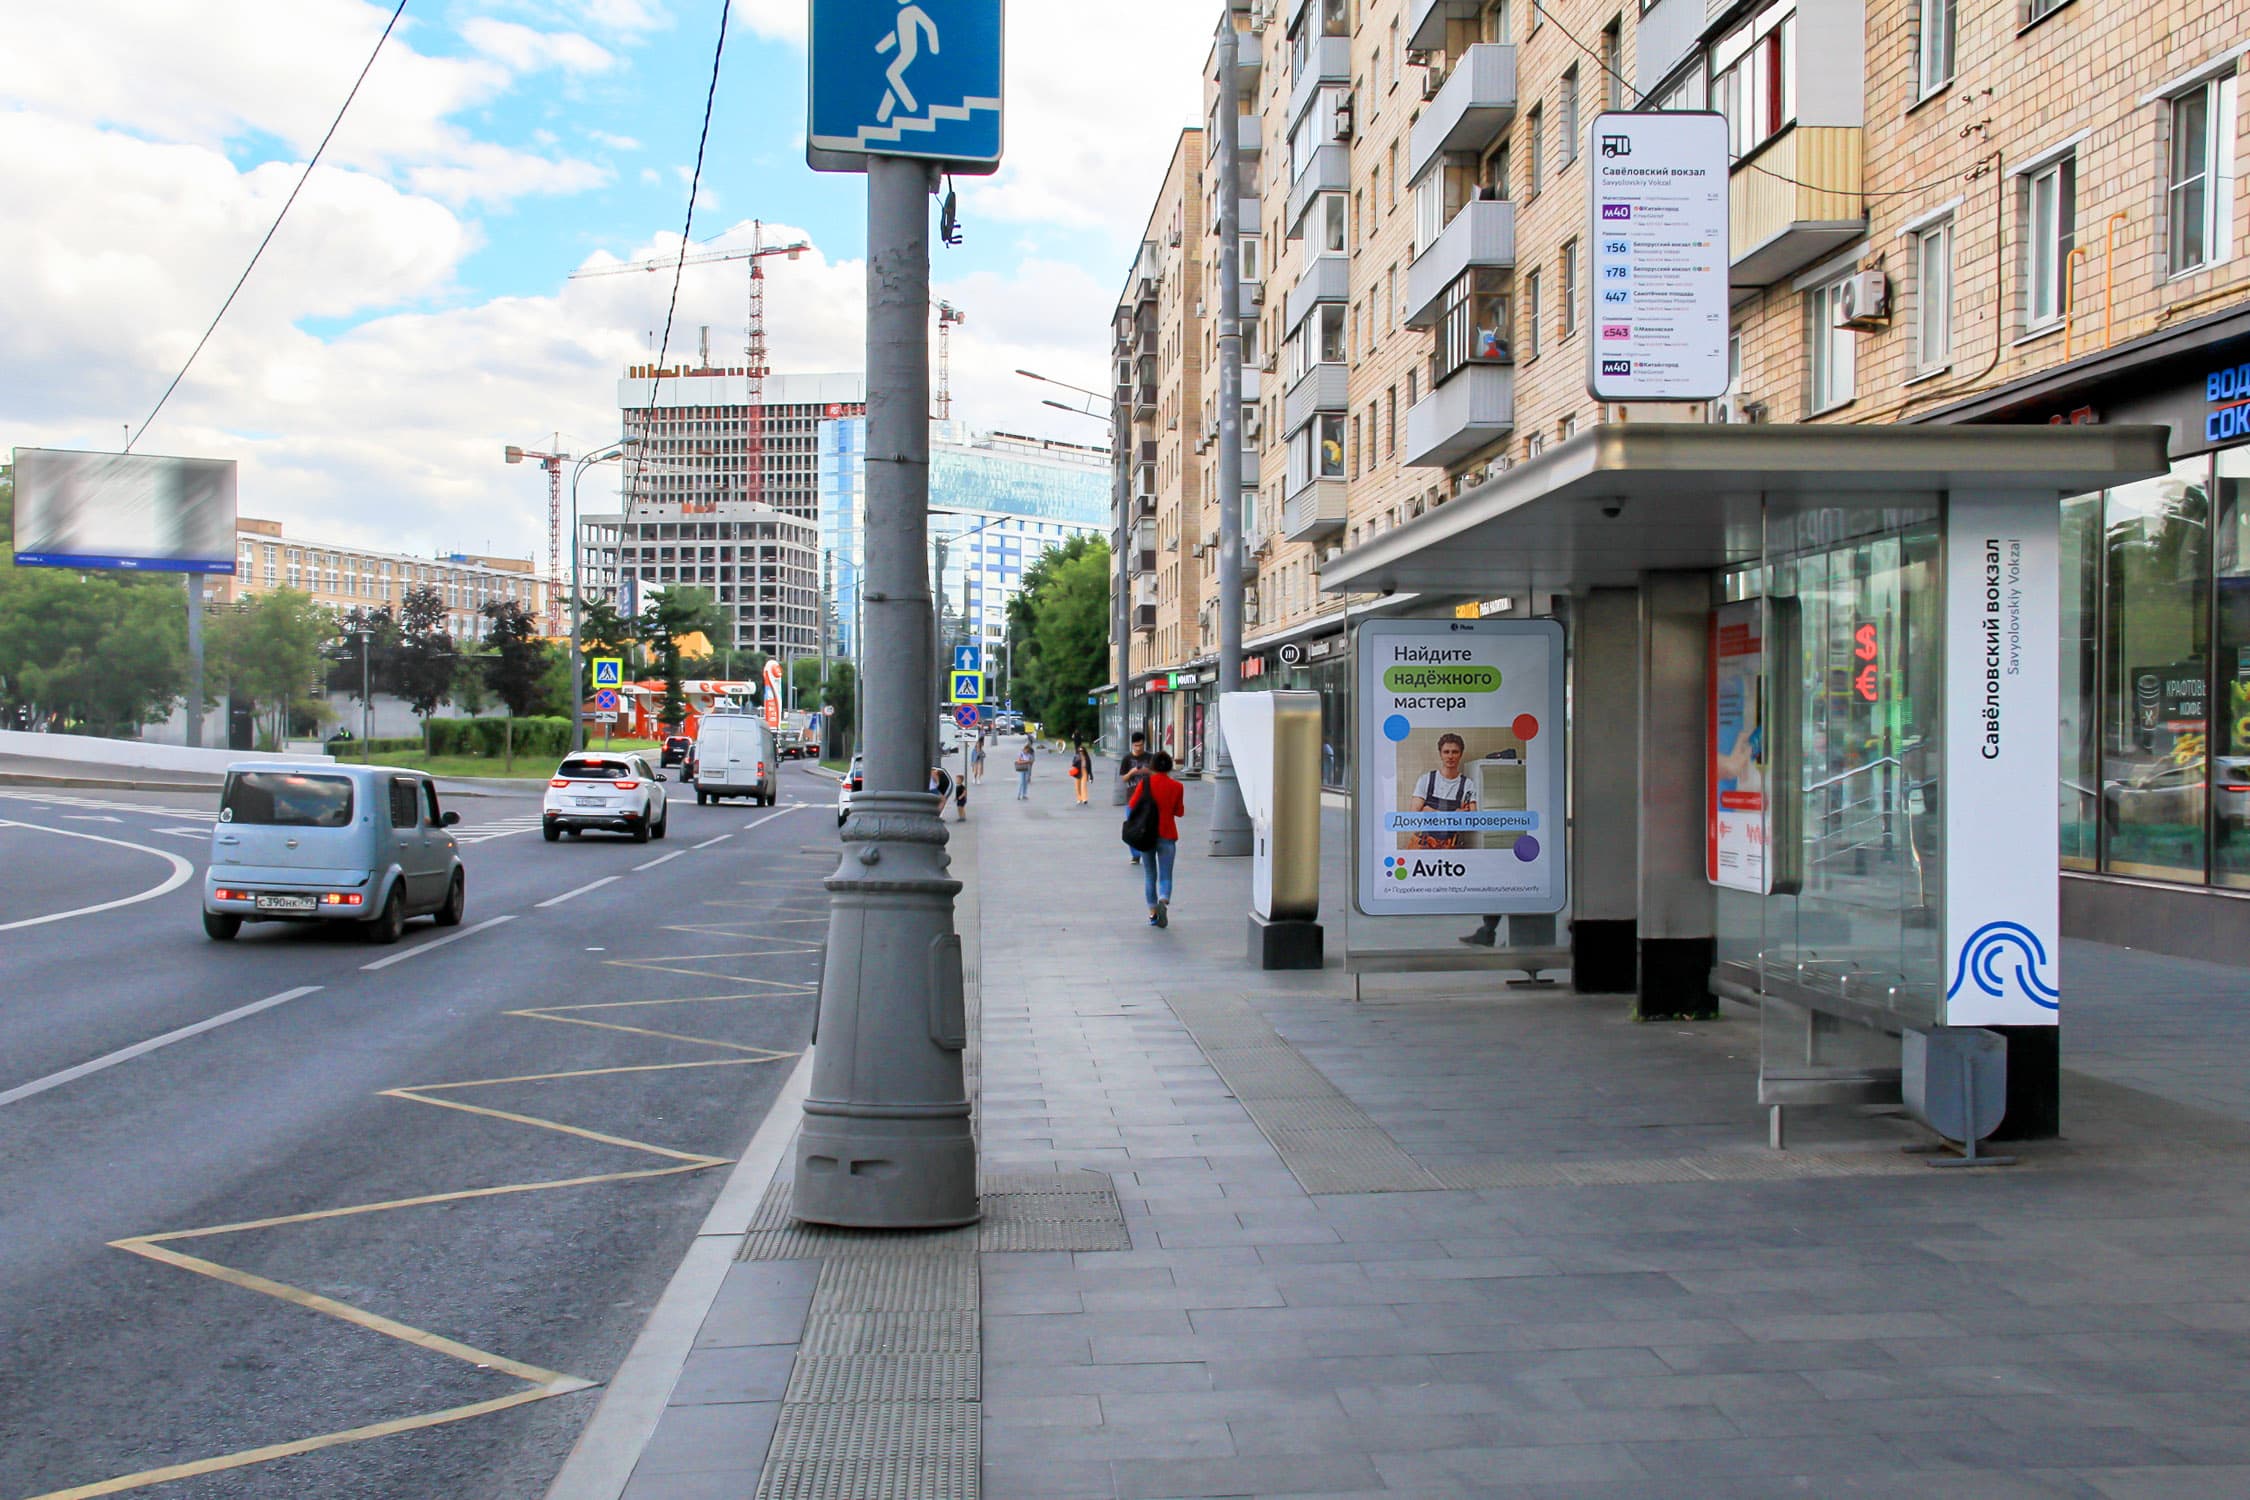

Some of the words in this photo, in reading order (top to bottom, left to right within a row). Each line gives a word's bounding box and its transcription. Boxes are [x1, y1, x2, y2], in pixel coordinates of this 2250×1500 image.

[1602, 167, 1669, 177] Савёловский
[1671, 169, 1706, 177] вокзал
[1605, 292, 1627, 302] 447
[2007, 539, 2020, 584] Vokzal
[1986, 539, 1999, 613] вокзал
[2007, 588, 2022, 676] Savyolovskiy
[1394, 646, 1472, 664] Найдите
[1394, 670, 1492, 688] надёжного
[1982, 618, 1999, 760] Савёловский
[1394, 696, 1467, 710] мастера
[1392, 814, 1463, 829] Документы
[1465, 816, 1531, 828] проверены
[1412, 859, 1466, 877] Avito
